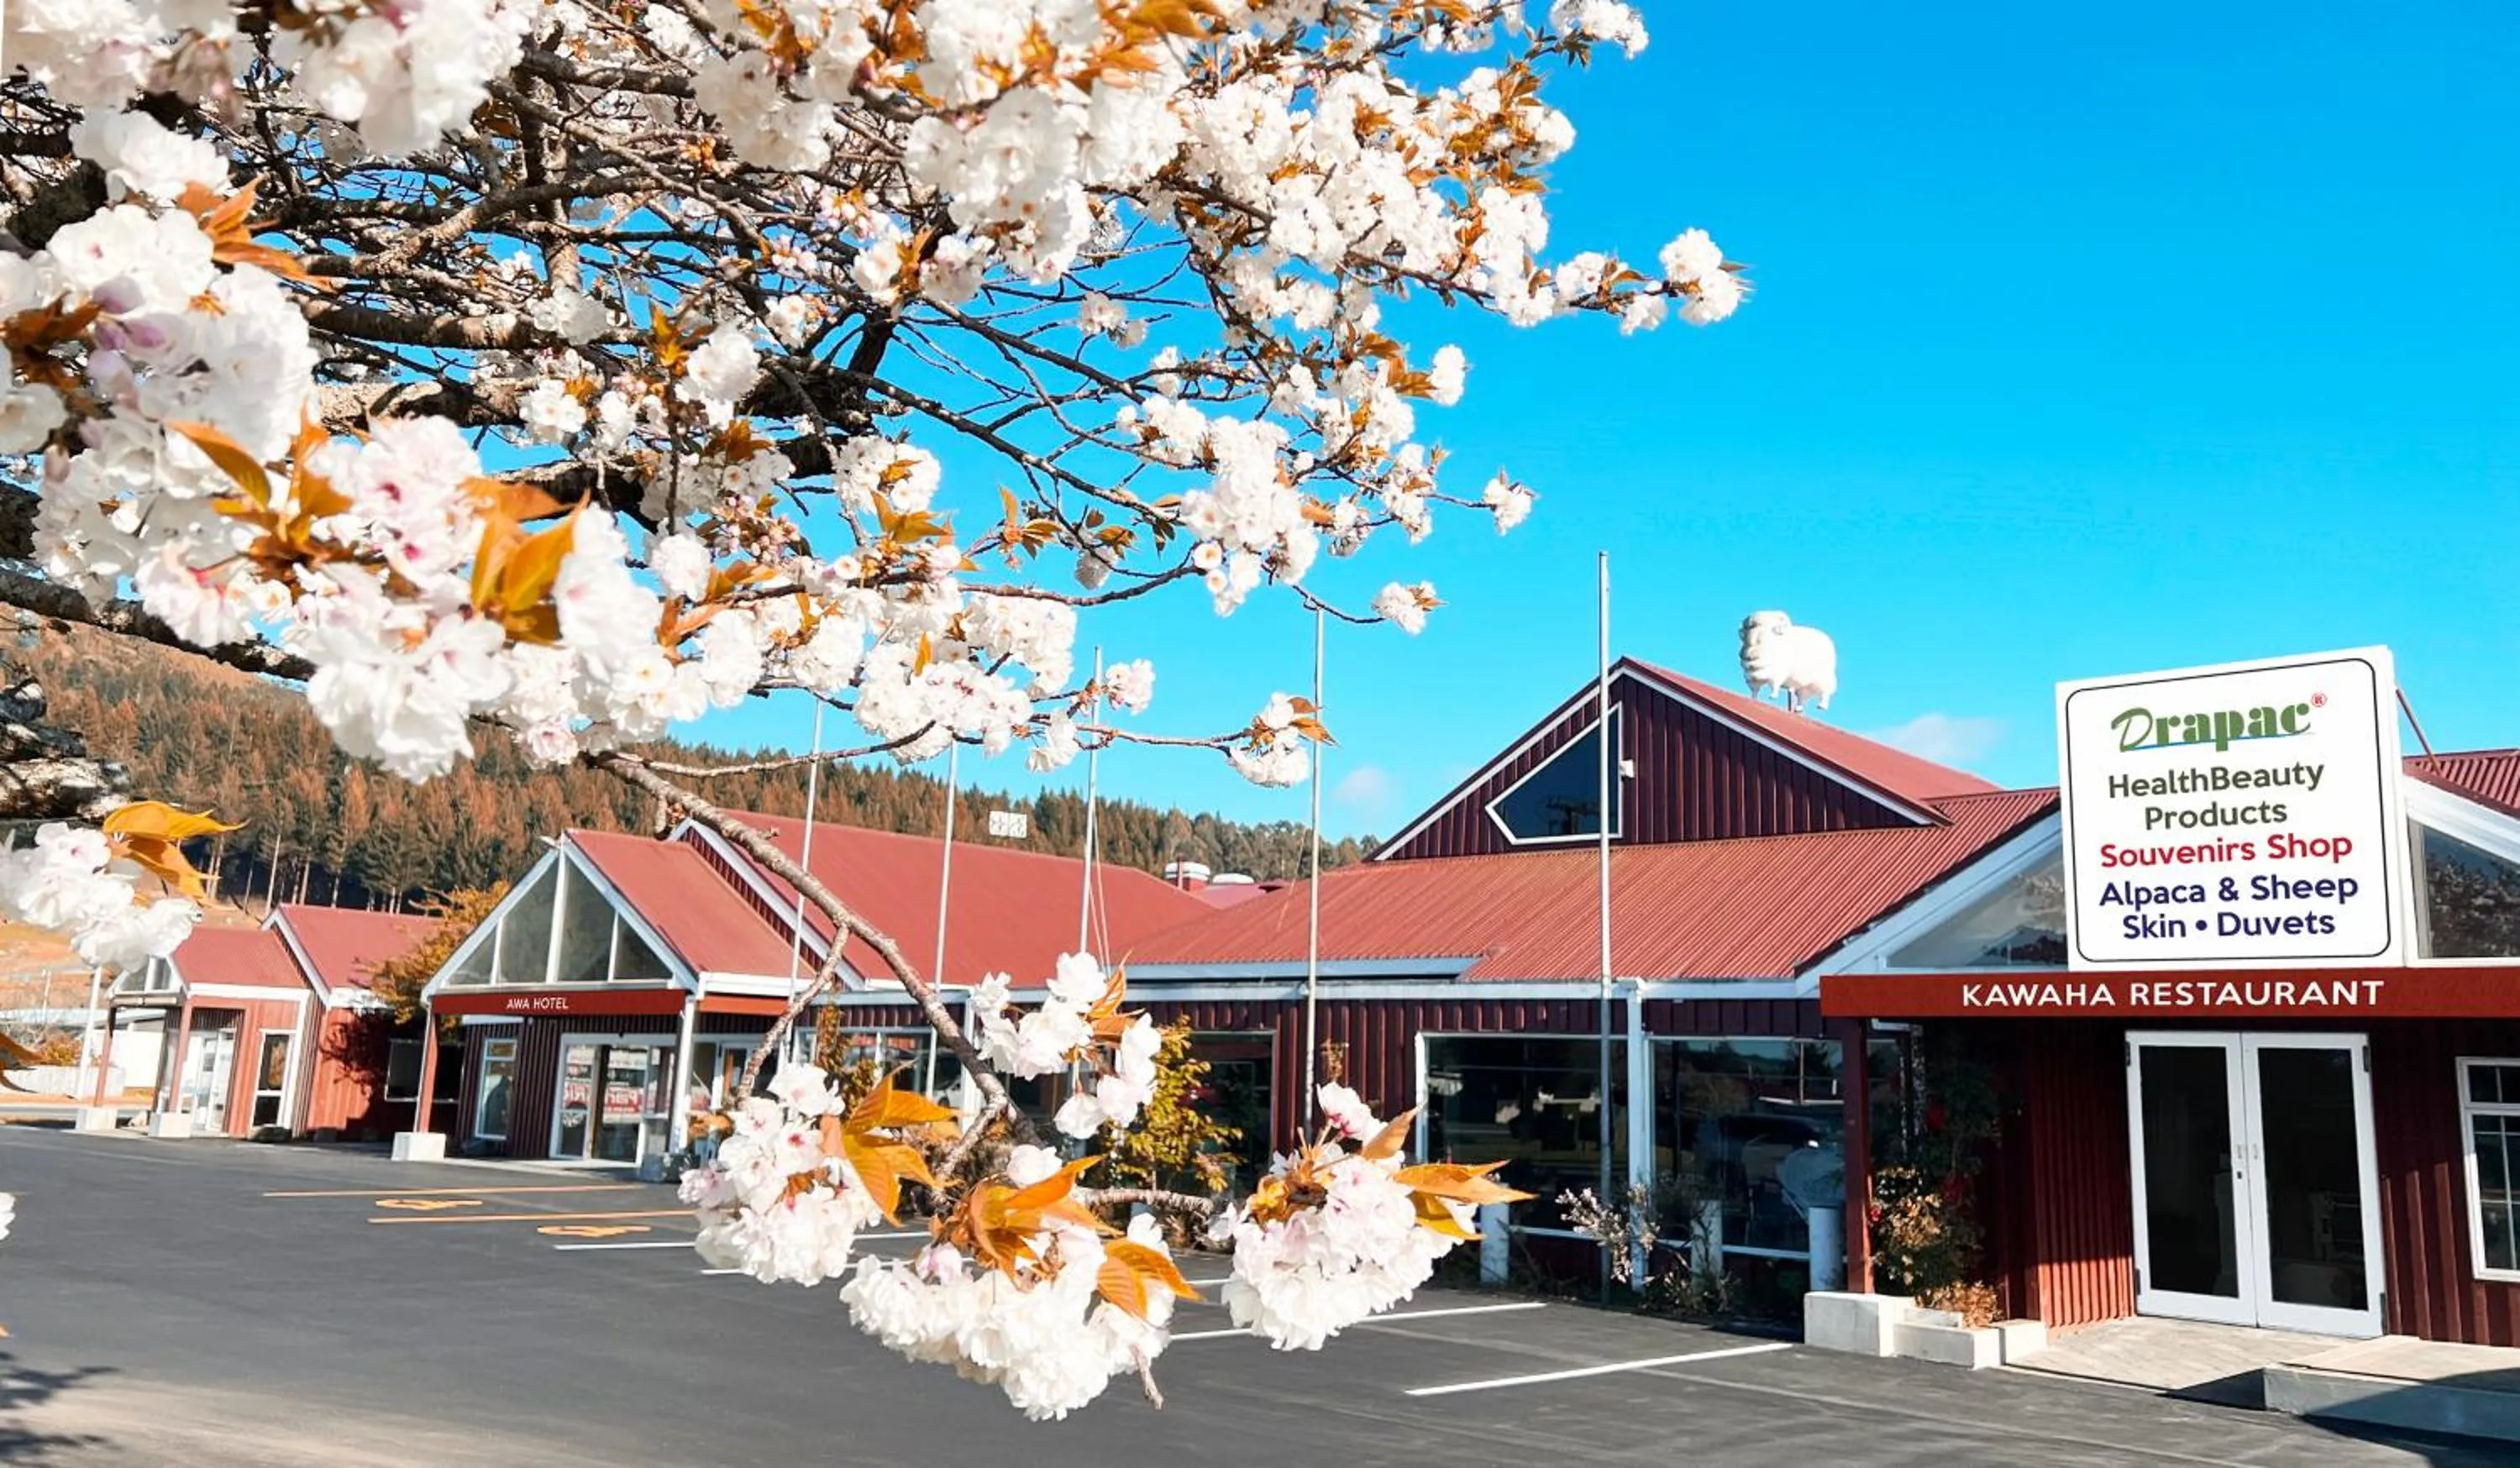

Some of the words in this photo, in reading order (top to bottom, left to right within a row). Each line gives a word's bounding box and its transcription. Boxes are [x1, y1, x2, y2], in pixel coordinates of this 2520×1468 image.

[2110, 703, 2312, 752] Drapac
[2145, 800, 2288, 831] Products
[2100, 836, 2256, 868] Souvenirs
[2267, 832, 2353, 864] Shop
[2098, 880, 2207, 913] Alpaca
[2218, 876, 2239, 903] &
[2250, 873, 2359, 904] Sheep
[2123, 913, 2187, 940] Skin
[2217, 910, 2336, 937] Duvets
[507, 998, 531, 1009] AWA
[533, 997, 570, 1009] HOTEL
[1961, 983, 2117, 1007] KAWAHA
[2129, 979, 2386, 1006] RESTAURANT
